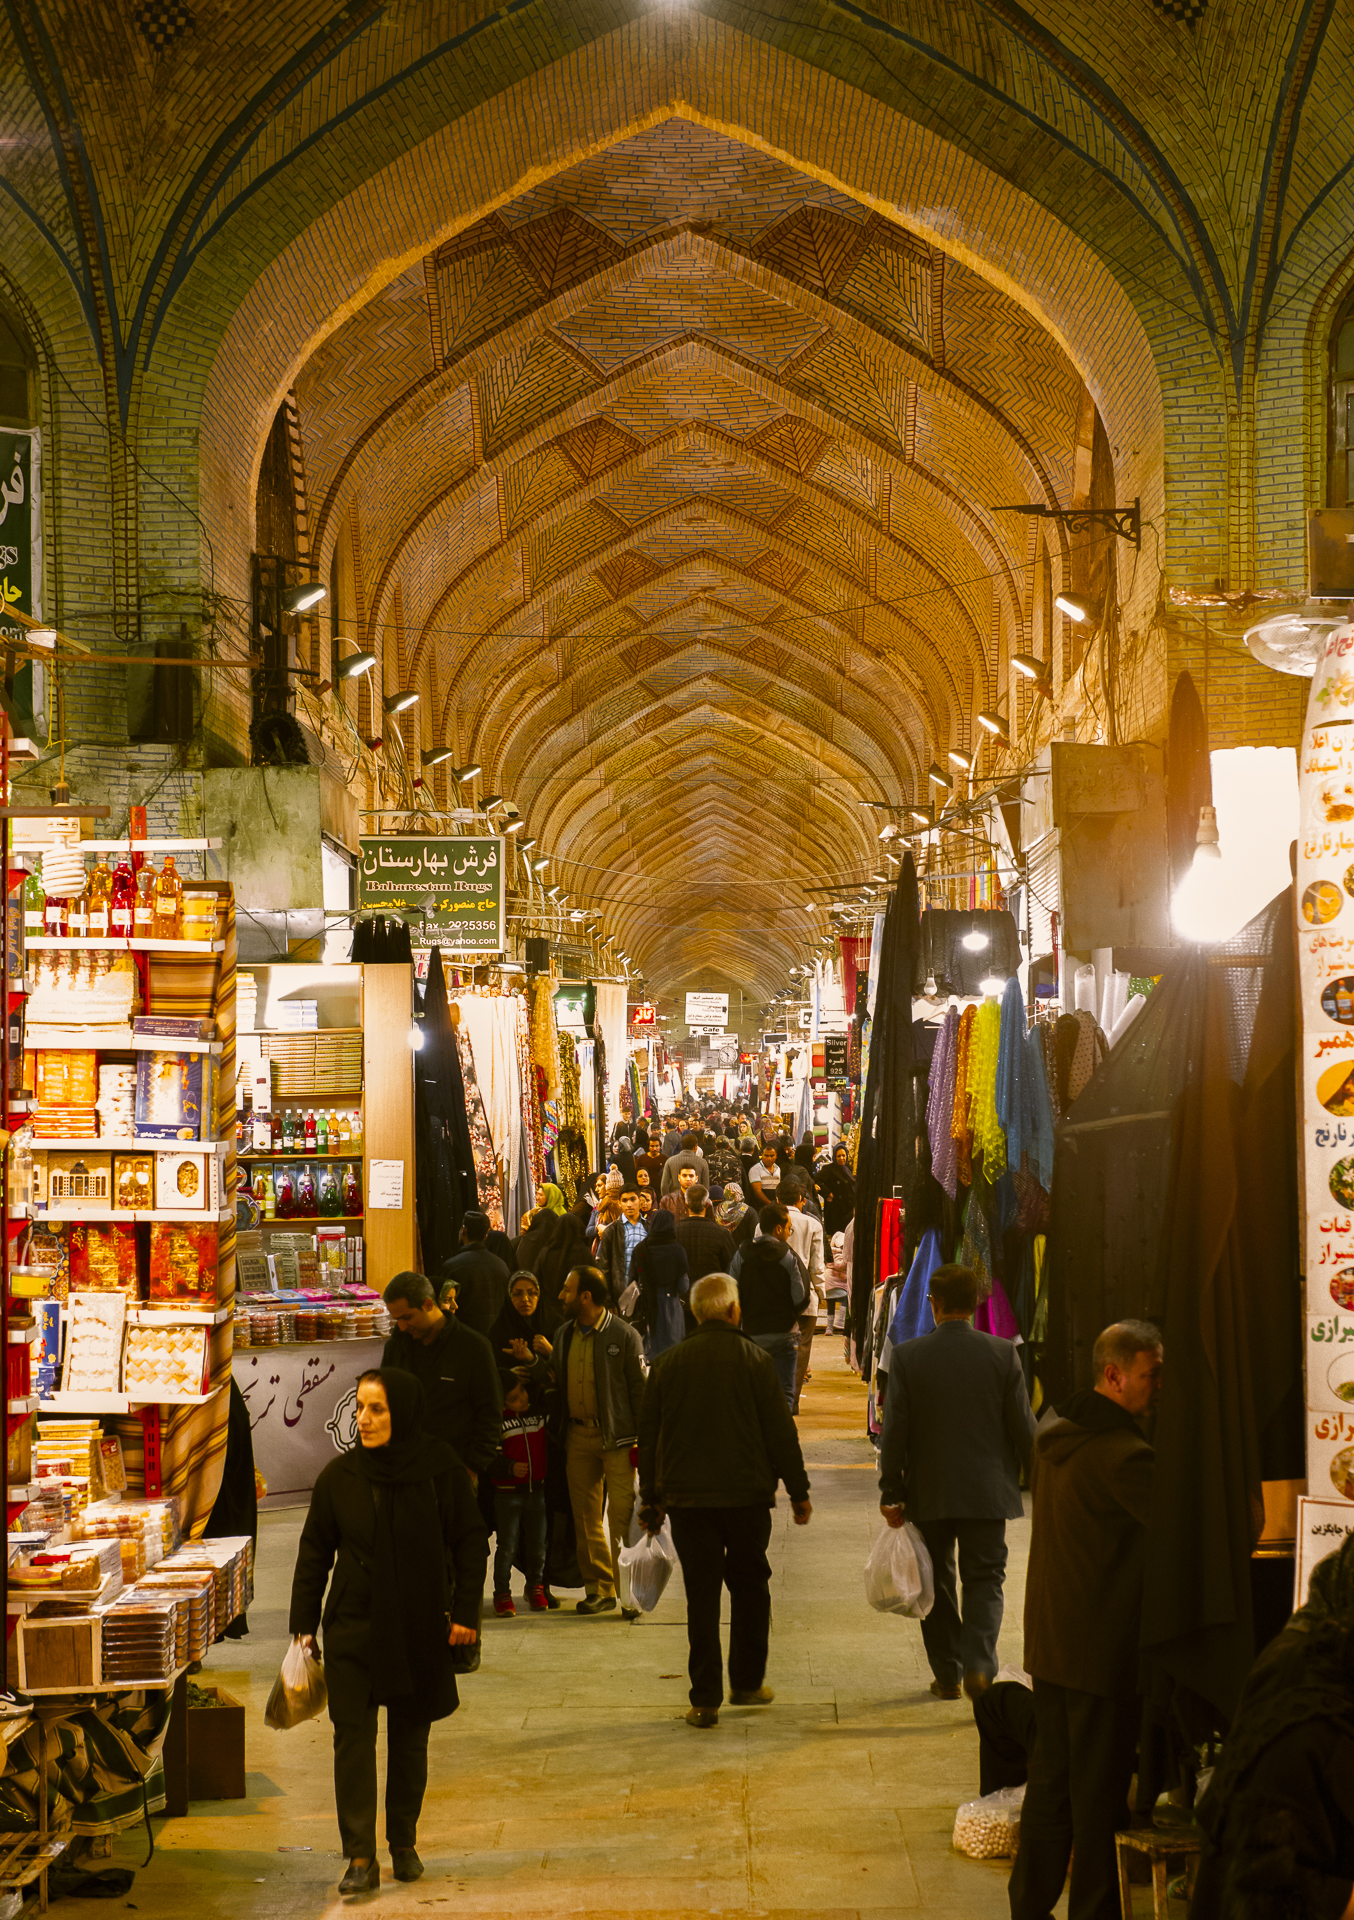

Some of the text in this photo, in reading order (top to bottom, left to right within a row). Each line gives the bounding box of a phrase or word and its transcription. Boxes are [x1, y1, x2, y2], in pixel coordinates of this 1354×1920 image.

[1304, 832, 1331, 860] نارنج
[363, 845, 497, 877] فرش بهارستان
[366, 880, 493, 894] Baharestan Rugs
[447, 900, 476, 912] منصور
[477, 899, 497, 912] حاج
[419, 920, 439, 931] Fax
[1315, 1123, 1347, 1148] نارنج
[283, 1356, 336, 1428] مسقطی
